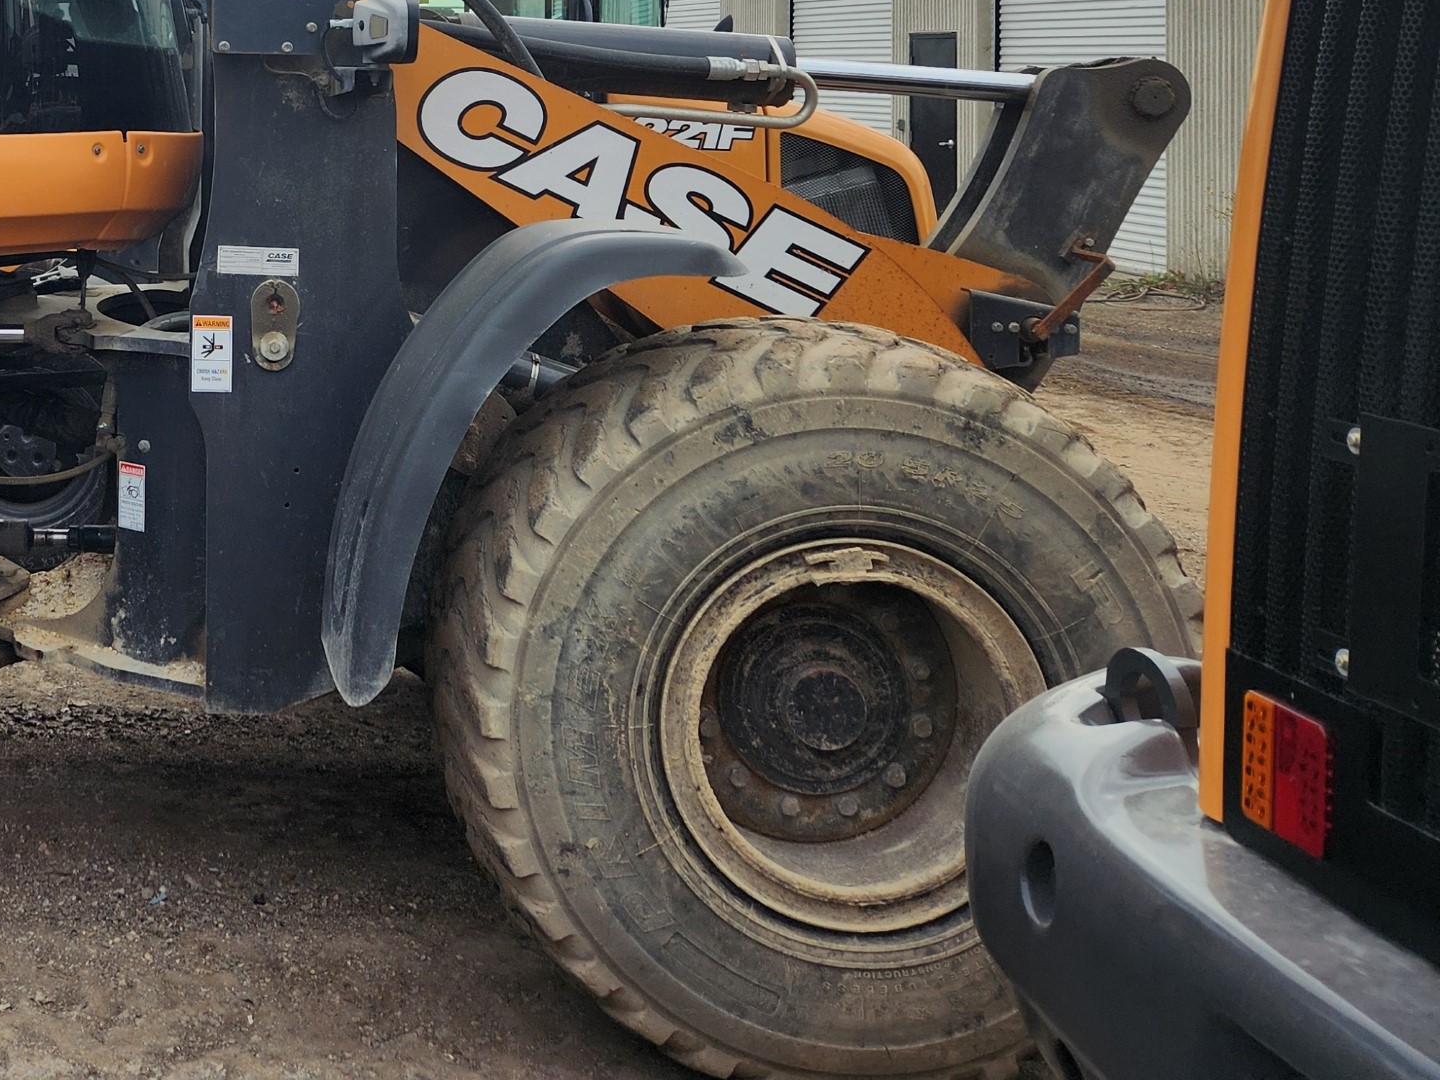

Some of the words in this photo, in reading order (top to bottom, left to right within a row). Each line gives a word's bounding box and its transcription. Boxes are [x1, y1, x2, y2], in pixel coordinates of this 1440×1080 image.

[417, 67, 871, 318] CASE
[267, 252, 293, 260] CASE
[203, 320, 230, 328] WARNING
